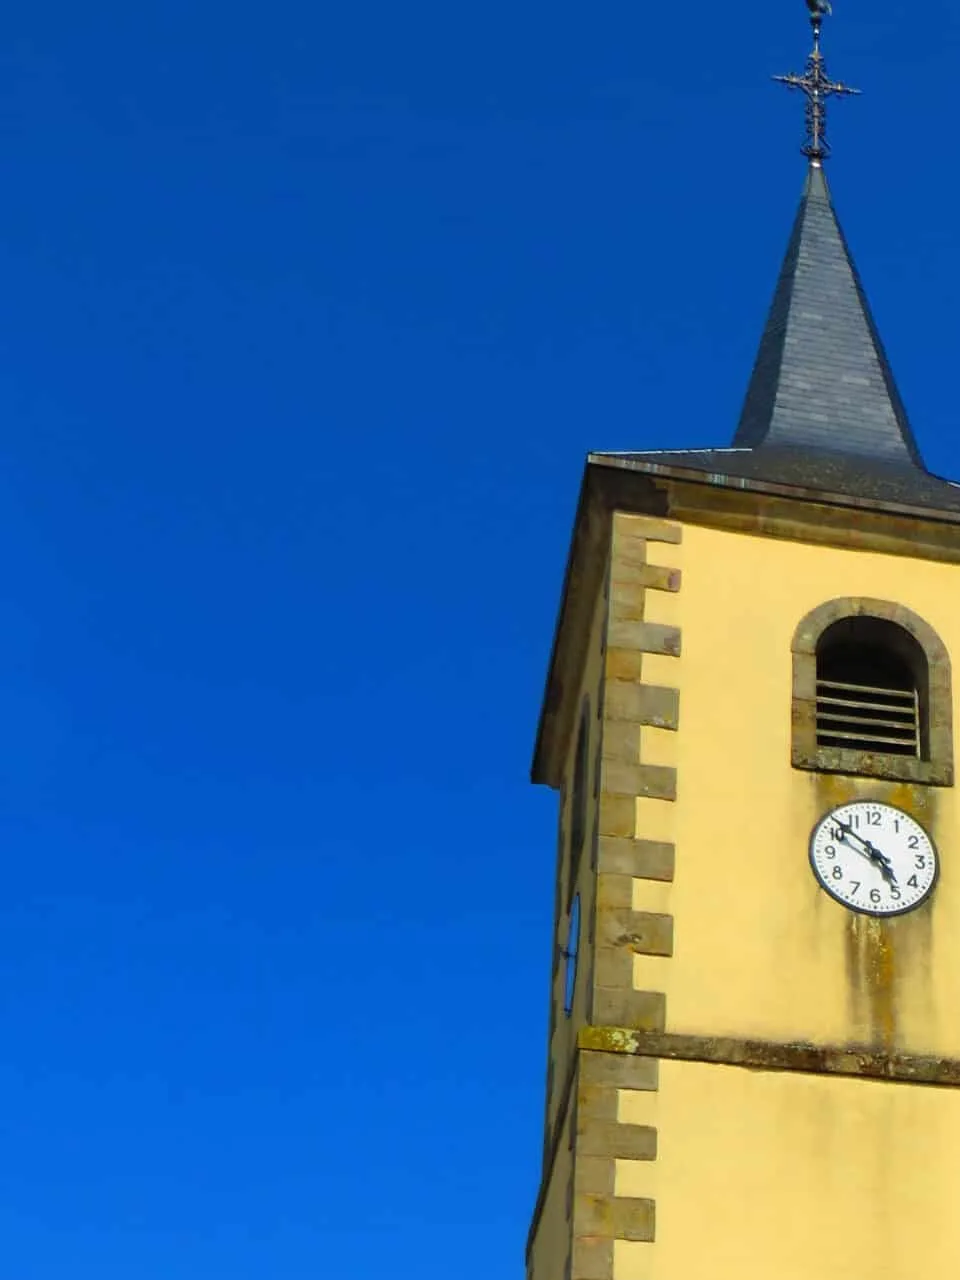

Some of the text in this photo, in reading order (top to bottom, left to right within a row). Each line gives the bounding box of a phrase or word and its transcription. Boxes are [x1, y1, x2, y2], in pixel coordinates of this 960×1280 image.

[849, 814, 859, 829] 11
[866, 811, 882, 826] 12
[894, 819, 899, 833] 1
[830, 827, 845, 841] 10
[908, 835, 919, 849] 2
[824, 845, 836, 859] 9
[915, 855, 926, 869] 3
[832, 865, 843, 880] 8
[849, 880, 861, 895] 7
[907, 874, 918, 888] 4
[869, 888, 881, 903] 6
[890, 885, 901, 900] 5
